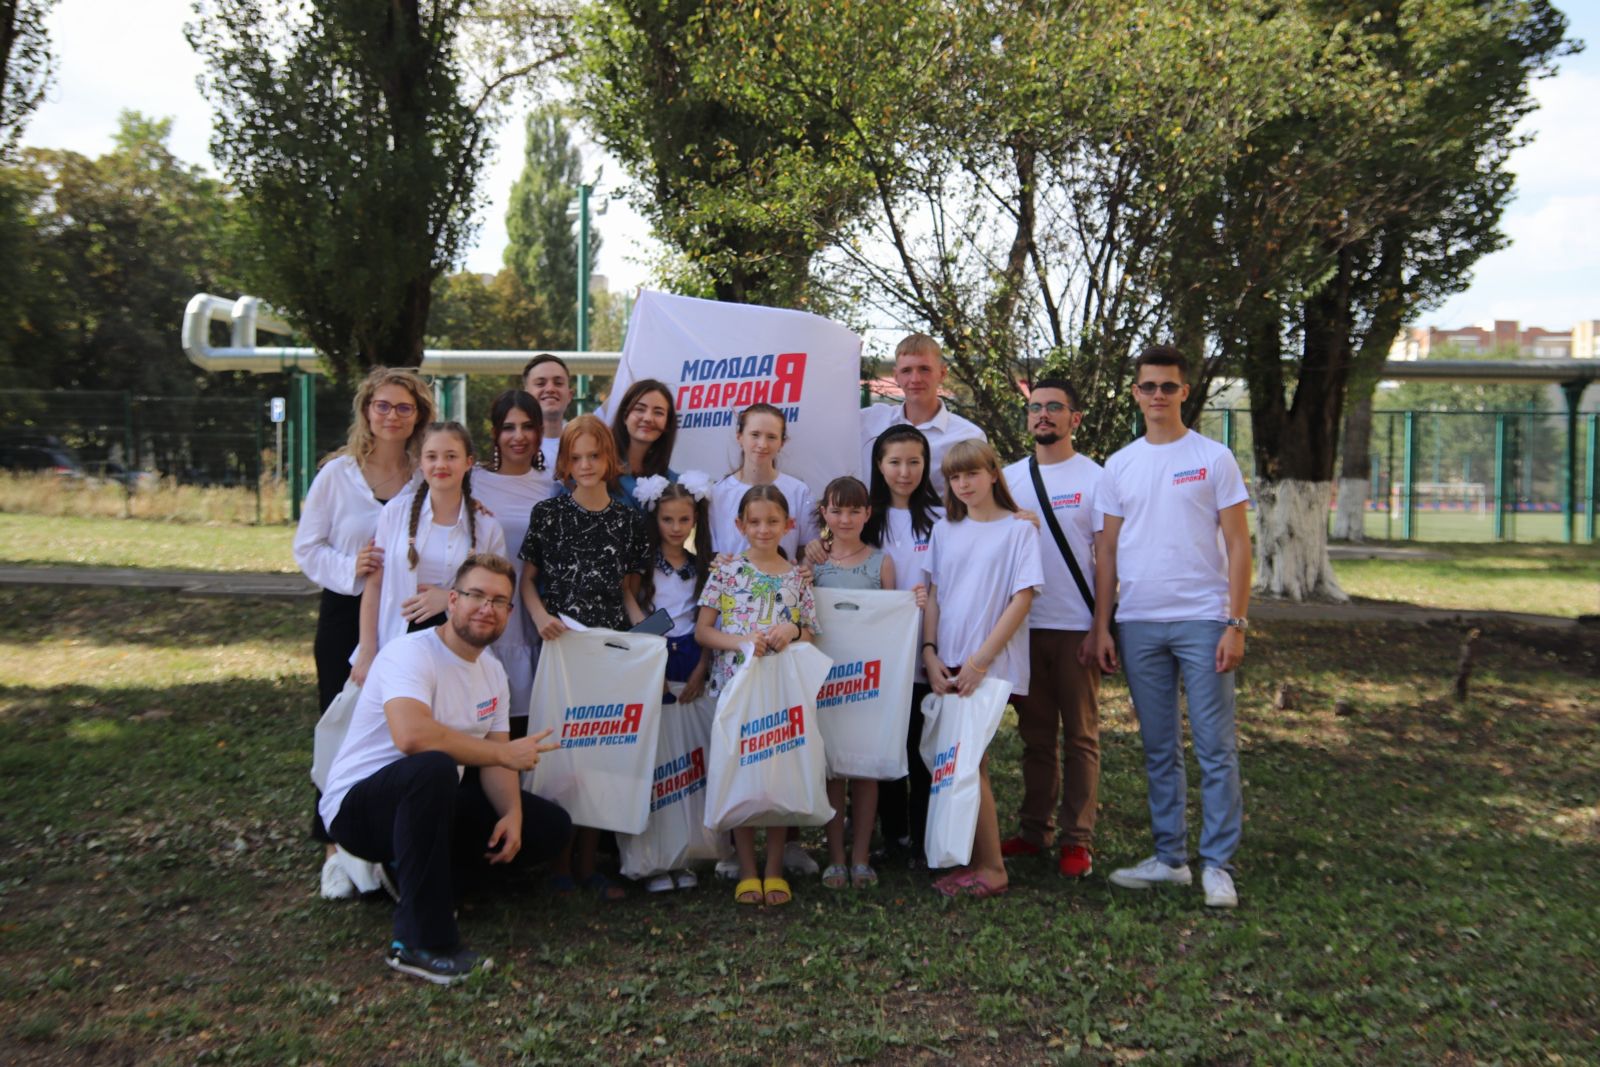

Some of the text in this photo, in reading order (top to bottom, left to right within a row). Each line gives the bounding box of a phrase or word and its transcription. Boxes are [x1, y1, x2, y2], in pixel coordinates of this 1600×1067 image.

[676, 371, 807, 411] ГВАРДИЯ
[675, 409, 734, 429] ЕДИНОЙ
[845, 689, 880, 704] РОССИИ
[562, 714, 644, 738] ГВАРДИЯ
[600, 734, 638, 746] РОССИИ
[741, 719, 804, 755] ГВАРДИЯ
[776, 736, 806, 755] РОССИИ
